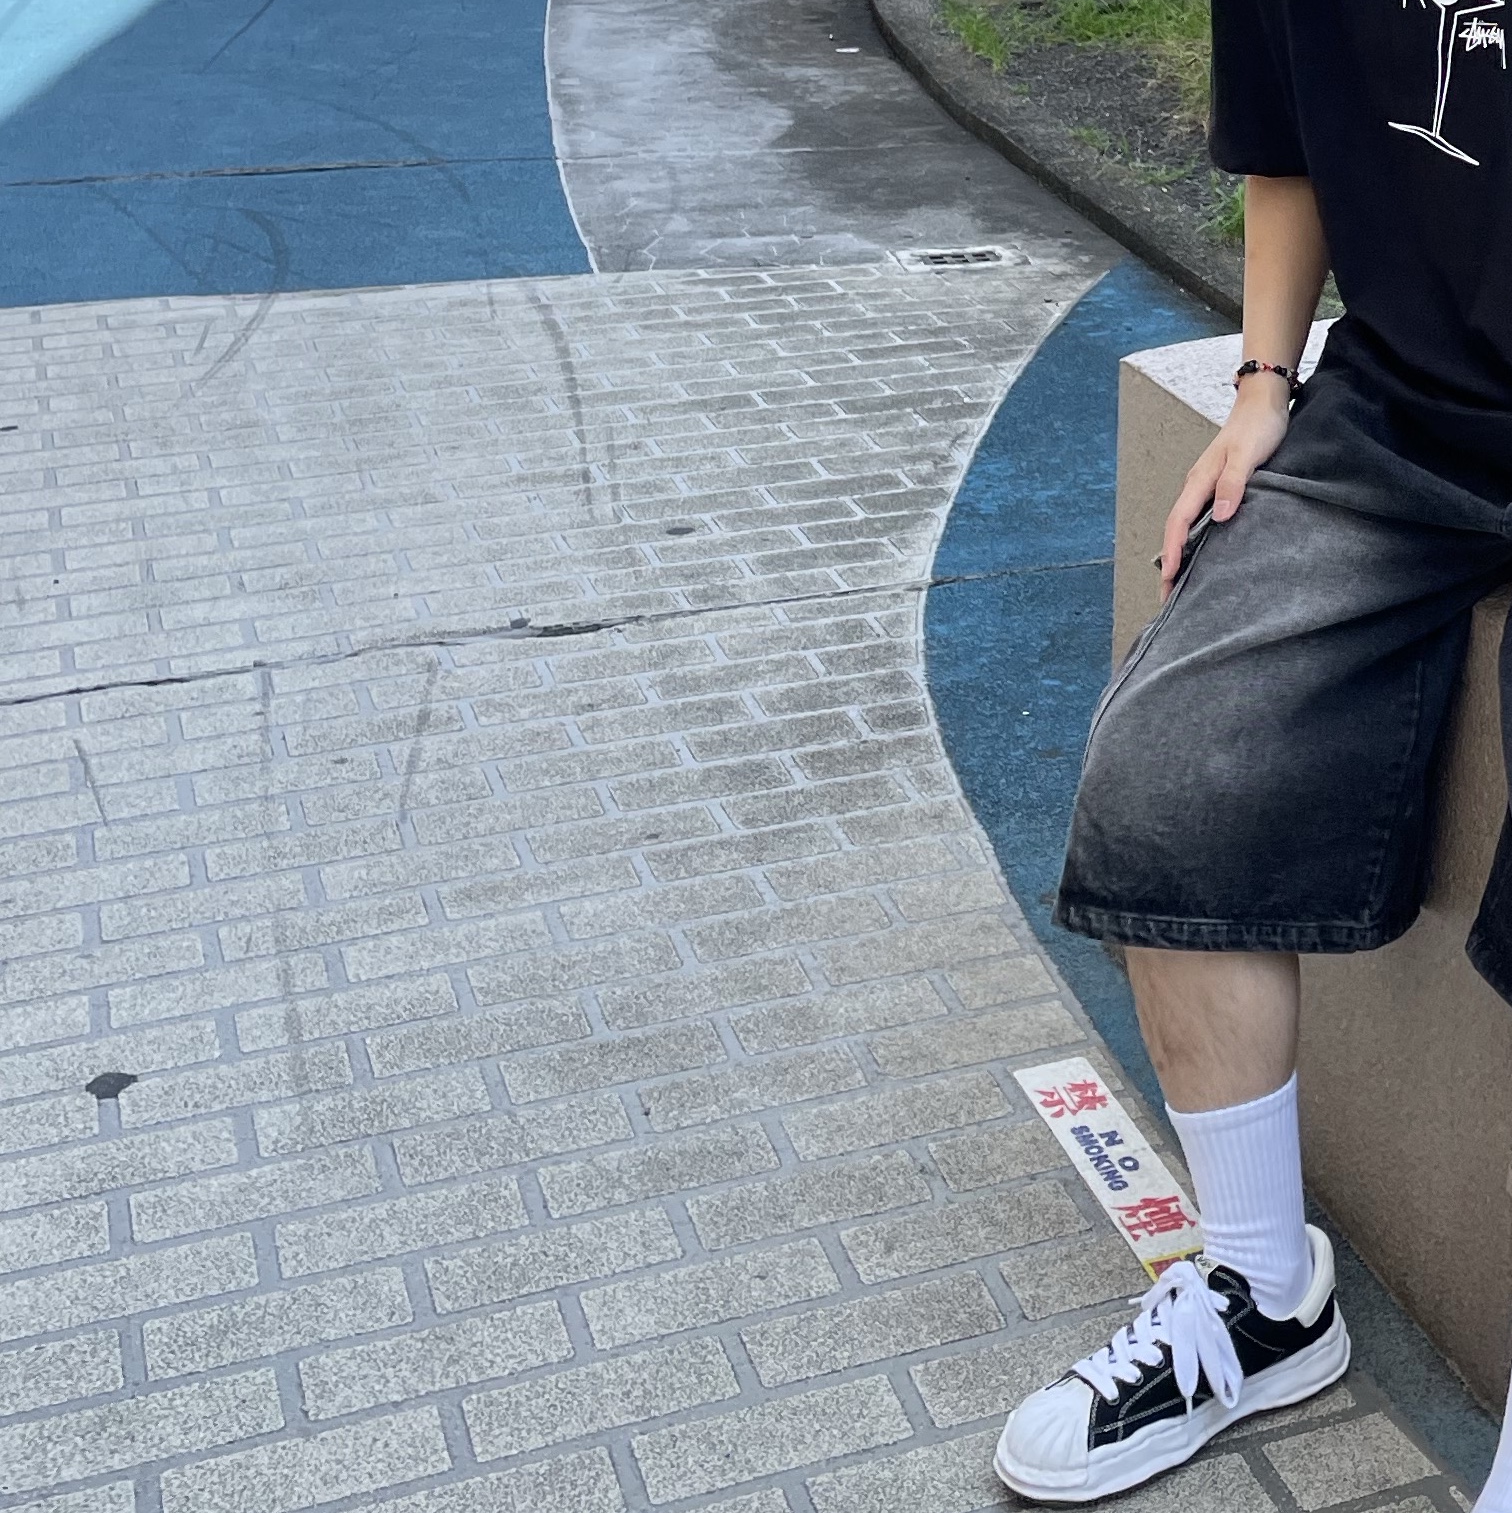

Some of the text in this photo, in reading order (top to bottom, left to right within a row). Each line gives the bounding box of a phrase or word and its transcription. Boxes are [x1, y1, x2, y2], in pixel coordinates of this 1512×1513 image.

[1034, 1079, 1109, 1118] 禁
[1070, 1125, 1129, 1191] SMOKING
[1099, 1129, 1140, 1172] NO
[1110, 1195, 1196, 1242] 煙
